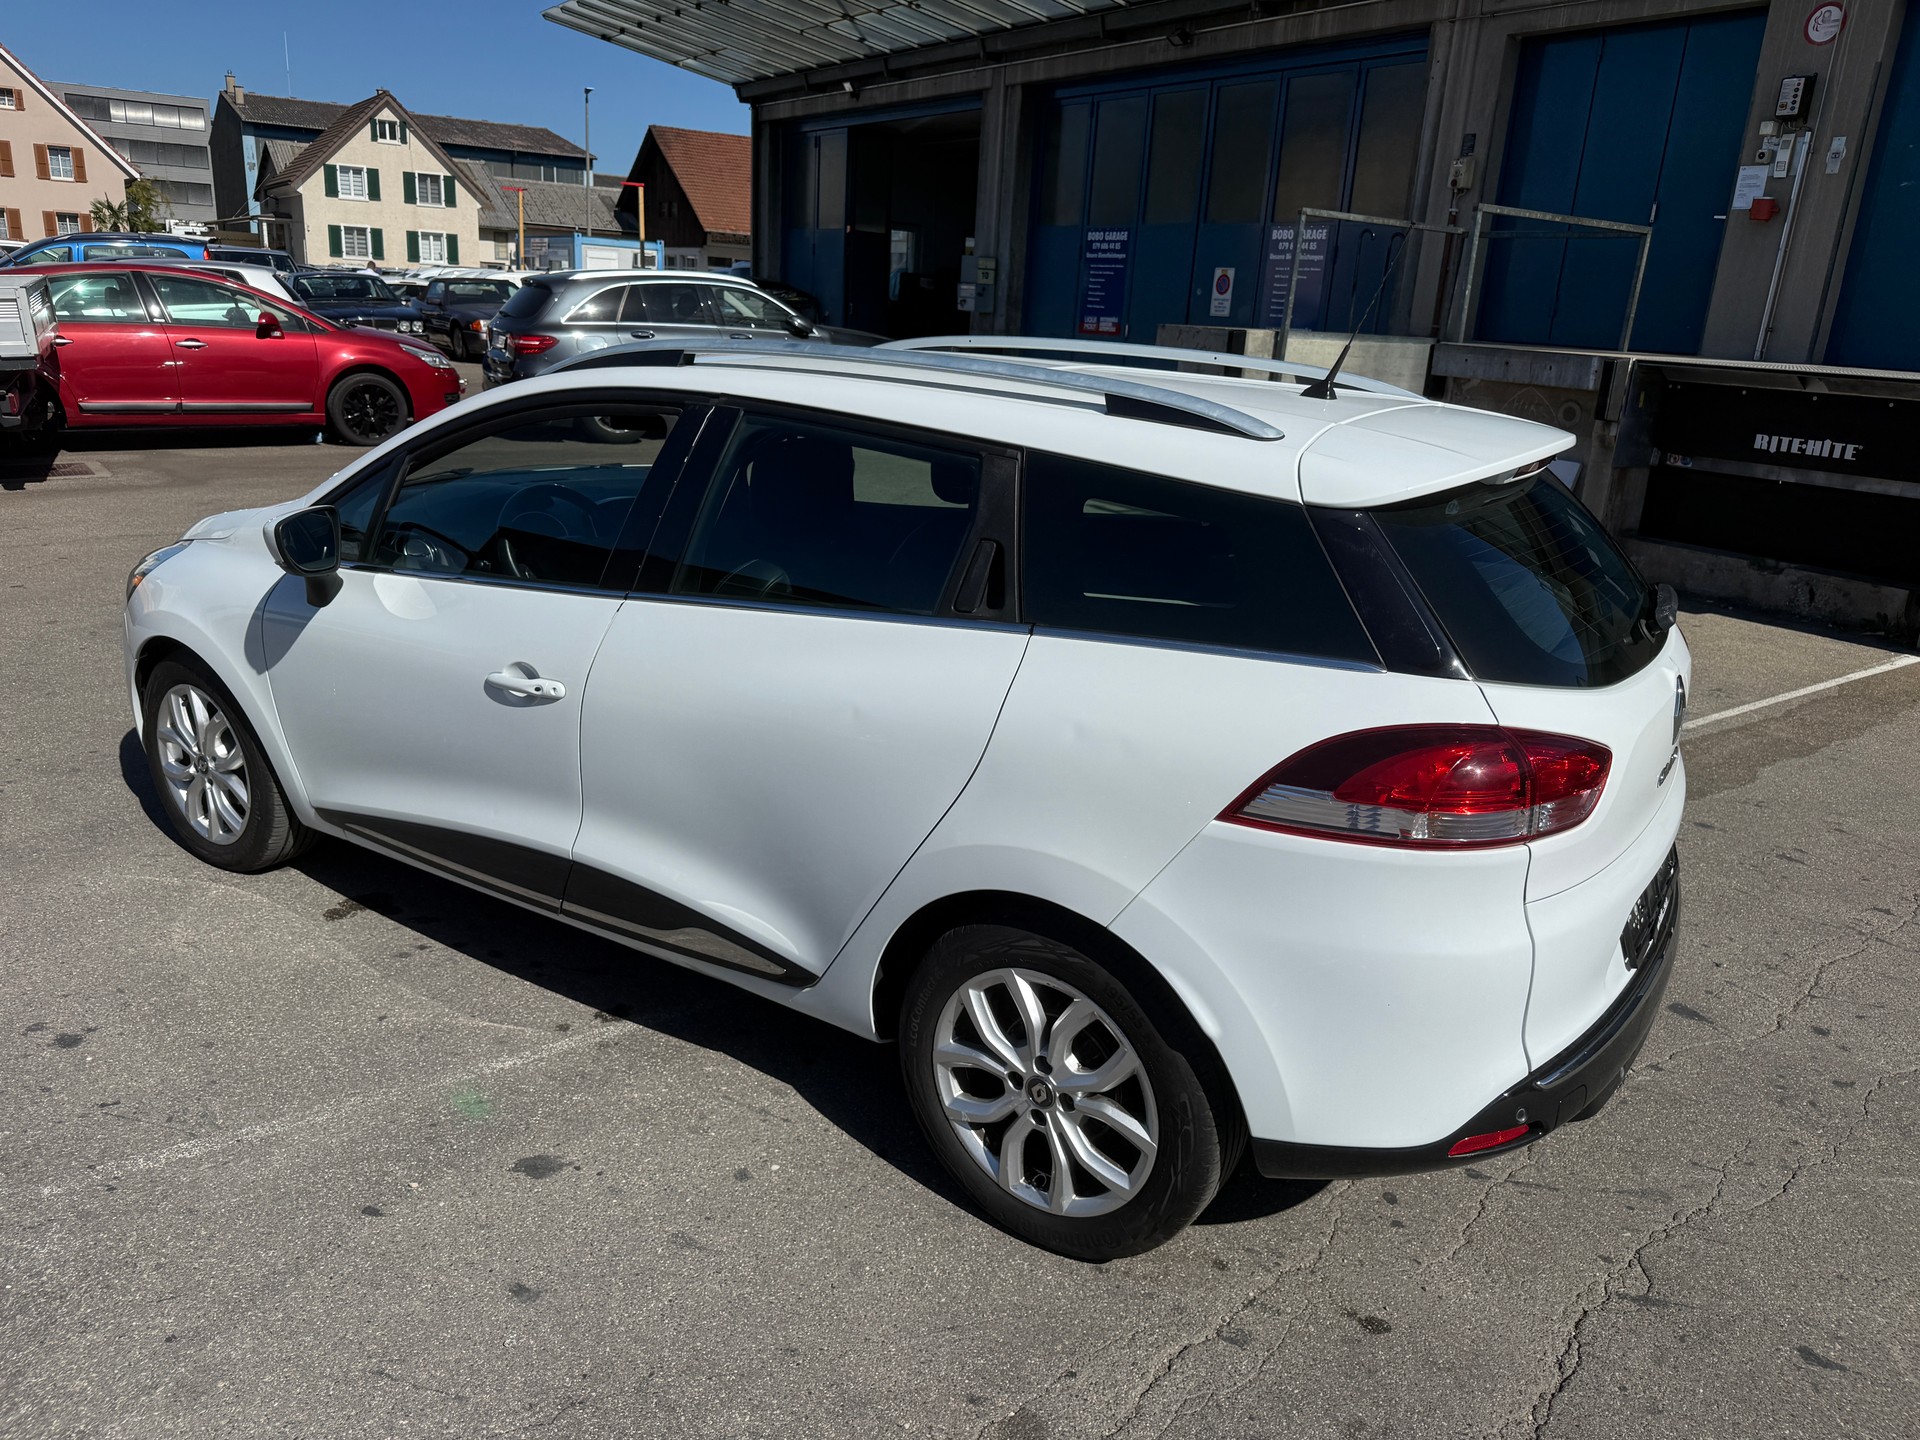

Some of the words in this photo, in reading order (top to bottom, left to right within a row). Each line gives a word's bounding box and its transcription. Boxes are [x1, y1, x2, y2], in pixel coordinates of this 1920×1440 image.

[1087, 232, 1104, 240] BOBO
[1105, 231, 1128, 240] GARAGE
[1272, 229, 1294, 239] BOBO
[1303, 229, 1327, 239] ARAGE
